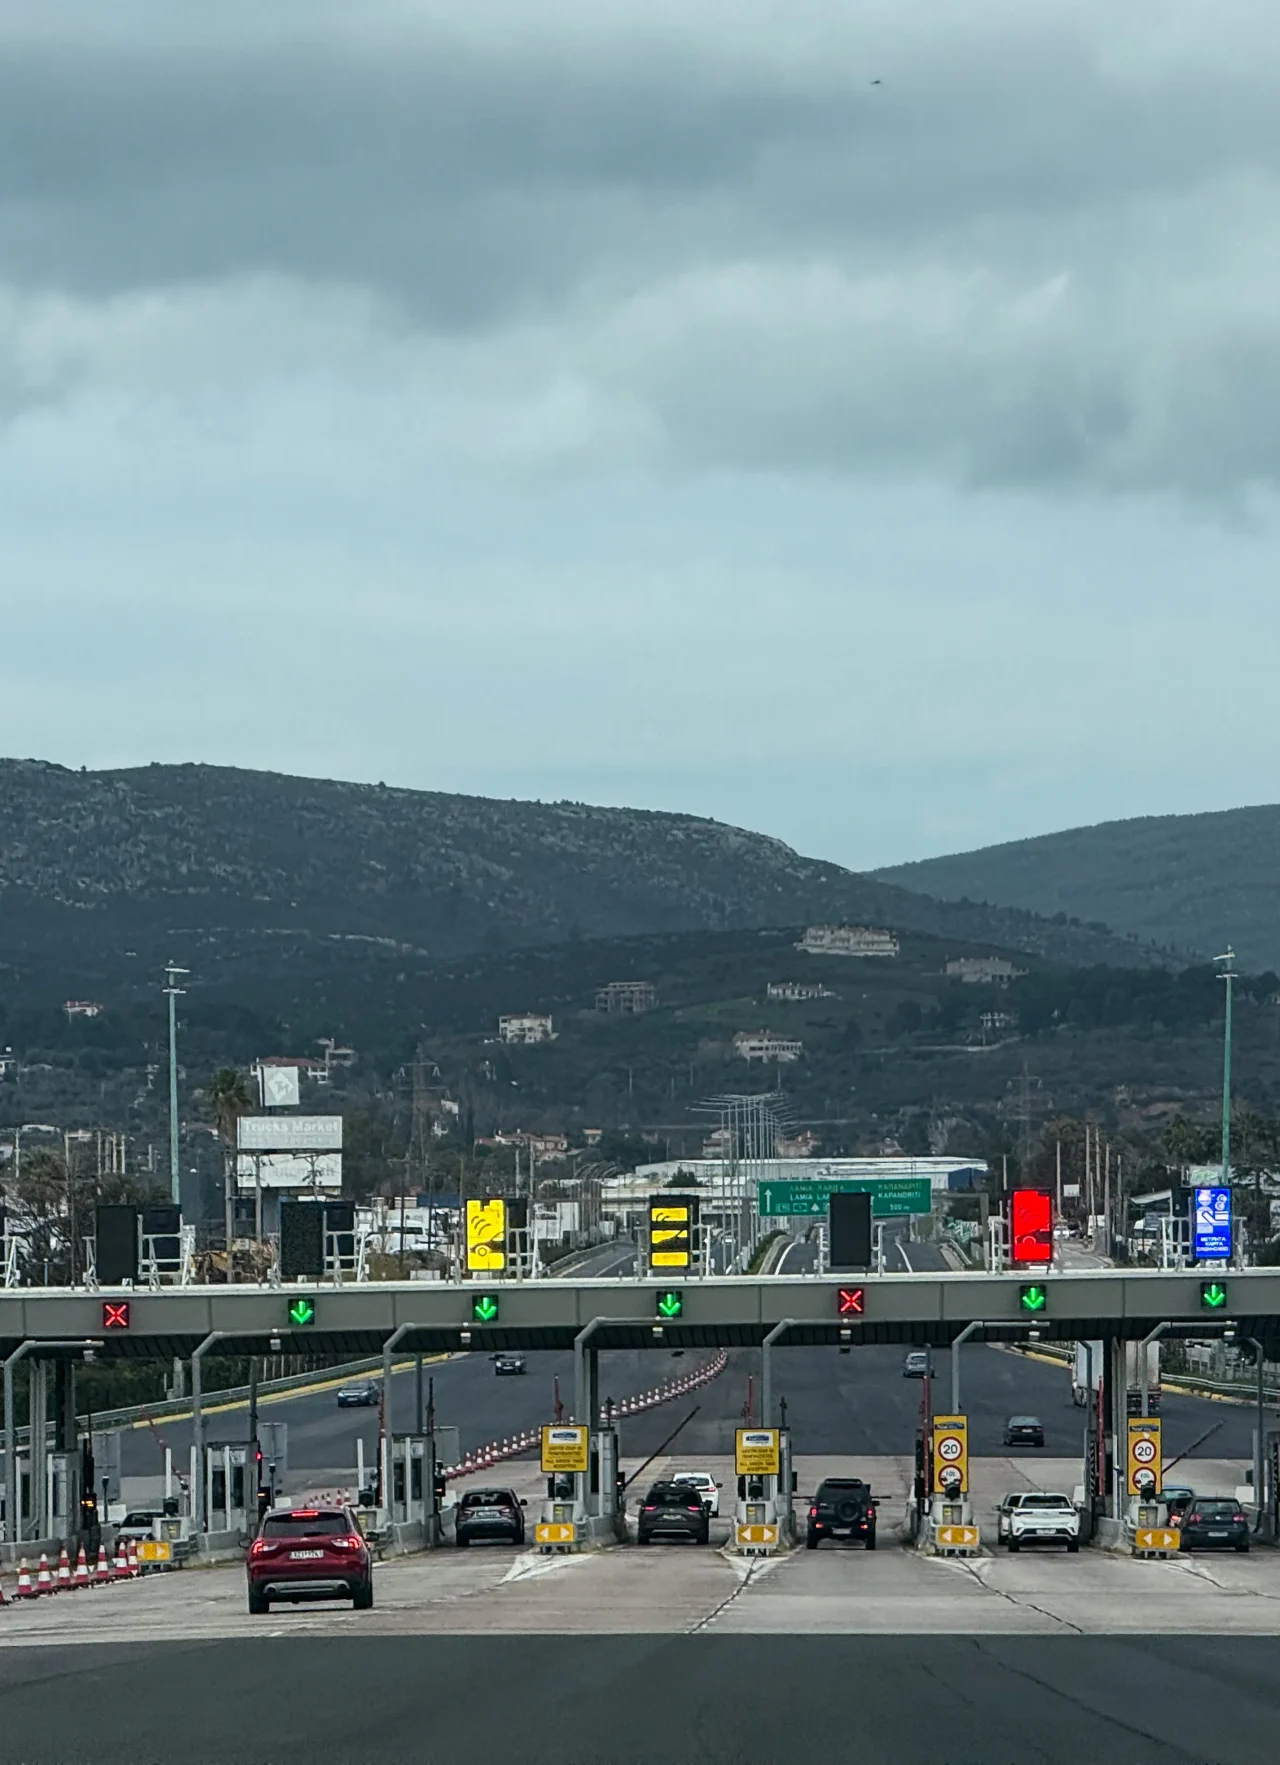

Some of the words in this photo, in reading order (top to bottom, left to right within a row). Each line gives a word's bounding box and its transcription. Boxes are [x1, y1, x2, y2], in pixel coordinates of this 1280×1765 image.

[243, 1120, 289, 1132] Trucks
[292, 1120, 339, 1132] Market
[789, 1193, 813, 1201] LAMIA
[878, 1191, 921, 1199] KAPANDRITI
[943, 1444, 959, 1454] 20
[1137, 1446, 1152, 1457] 20
